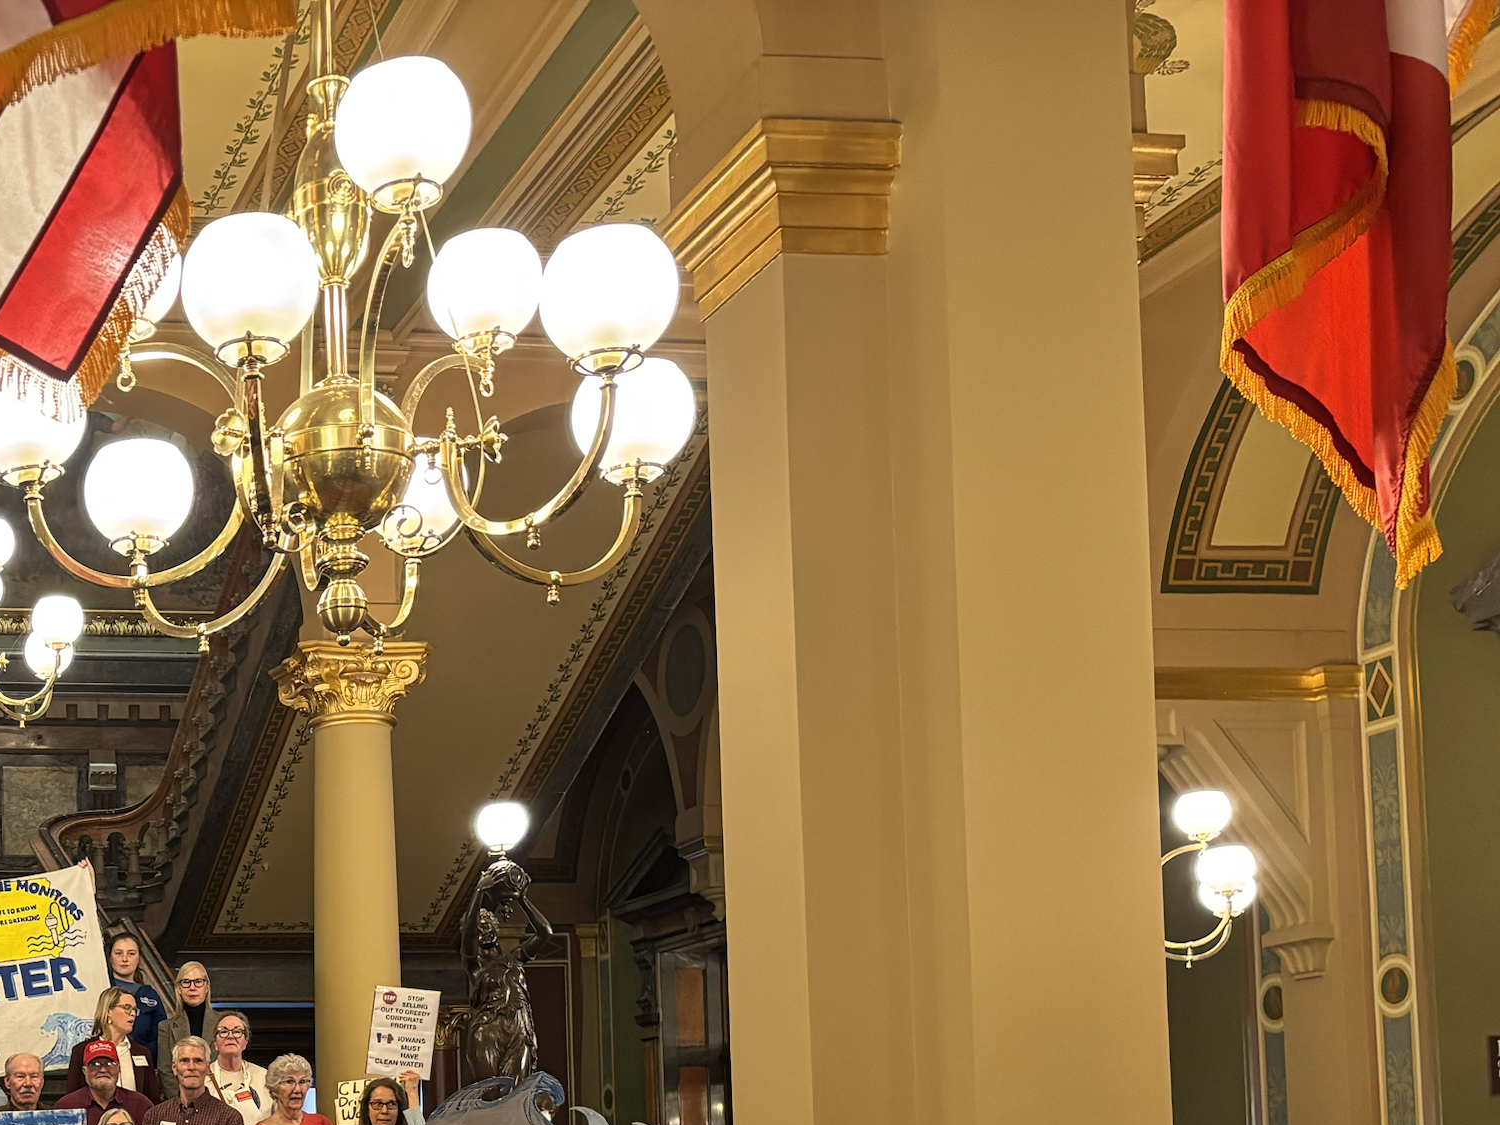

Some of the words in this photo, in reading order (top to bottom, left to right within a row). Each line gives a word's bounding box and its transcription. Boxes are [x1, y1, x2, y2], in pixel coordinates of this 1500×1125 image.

[16, 879, 84, 921] MONITORS
[408, 994, 425, 1002] STOP
[402, 1002, 428, 1010] SELLING
[405, 1009, 431, 1017] GREEDY
[385, 1014, 424, 1024] CORPORATE
[390, 1022, 417, 1030] PROFITS
[398, 1036, 426, 1044] IOWANS
[401, 1044, 421, 1052] MUST
[400, 1052, 419, 1060] HAVE
[374, 1057, 399, 1066] CLEAN
[399, 1060, 424, 1069] WATER
